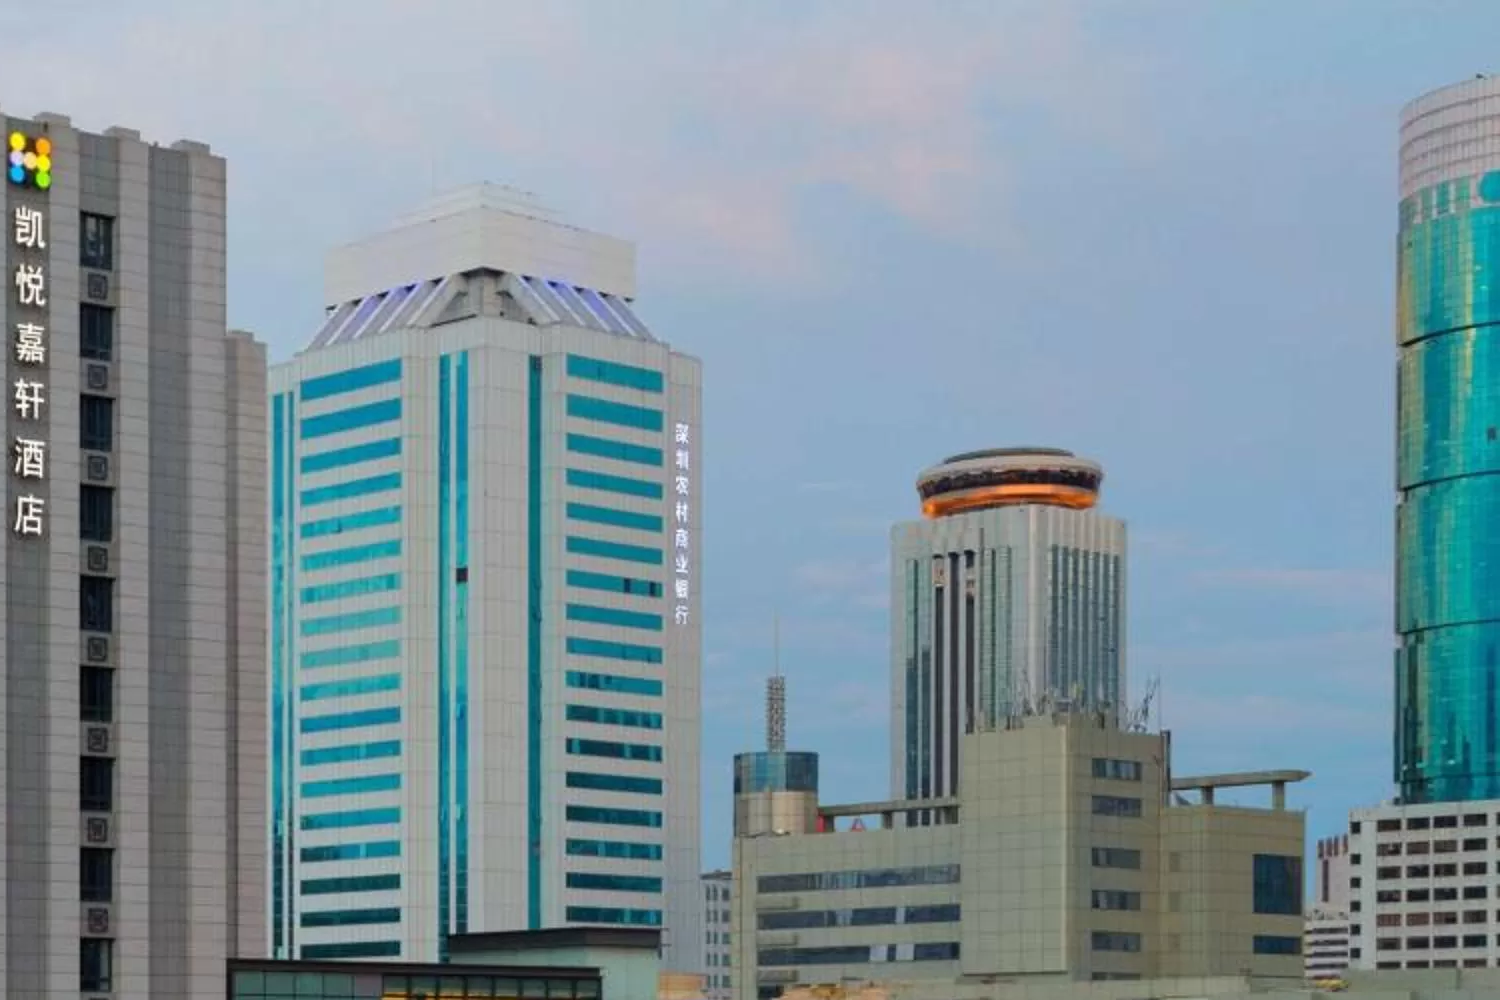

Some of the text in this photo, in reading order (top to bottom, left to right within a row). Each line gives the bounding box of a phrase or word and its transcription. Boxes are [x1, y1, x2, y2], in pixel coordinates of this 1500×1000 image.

[14, 205, 46, 536] 凯悦嘉轩酒店
